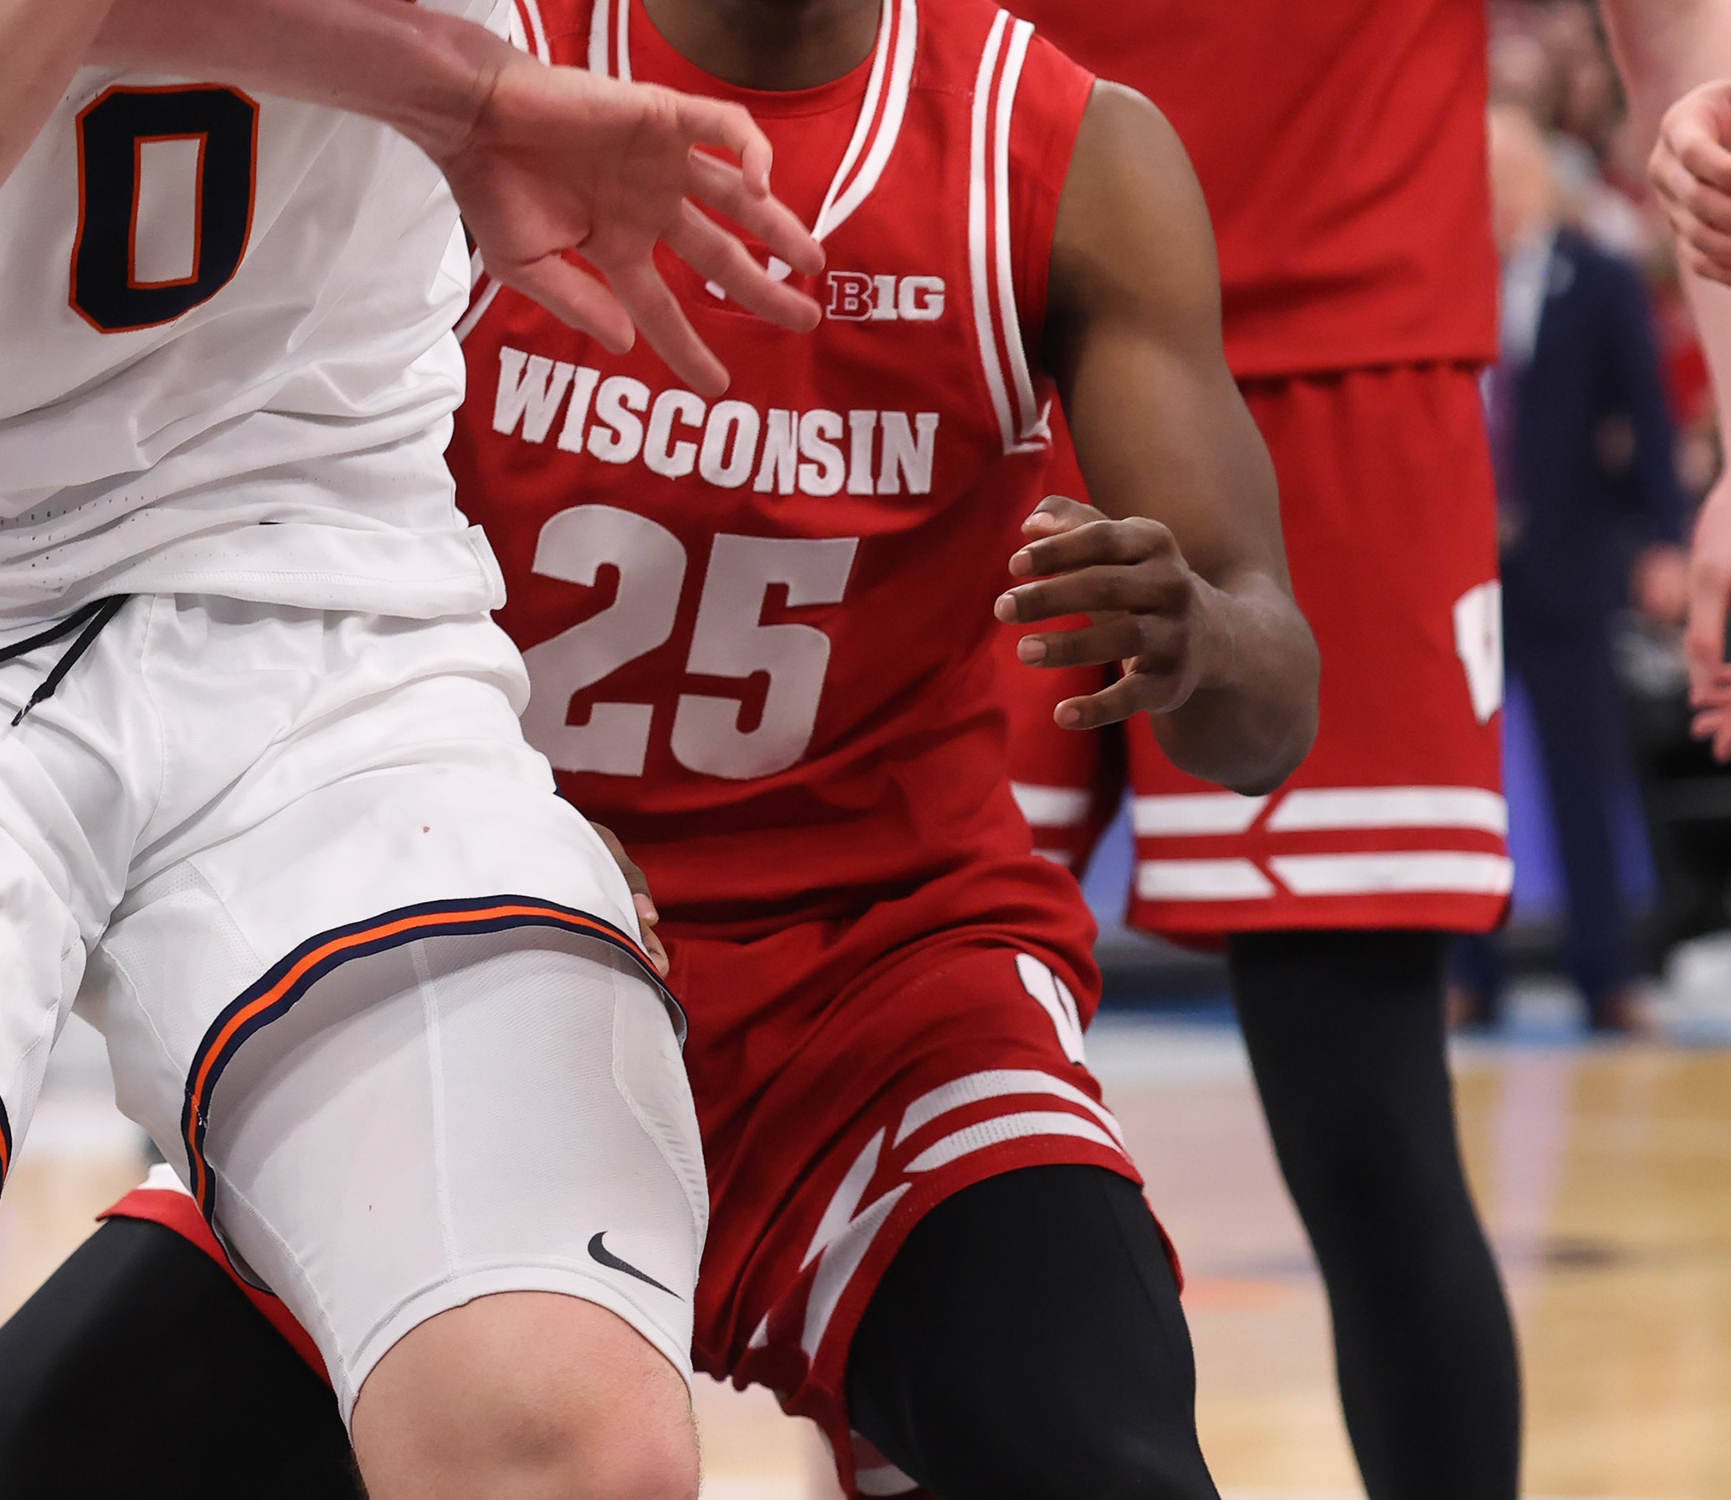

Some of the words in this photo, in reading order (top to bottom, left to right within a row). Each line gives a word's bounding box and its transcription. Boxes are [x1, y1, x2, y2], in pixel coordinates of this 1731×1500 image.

[69, 82, 260, 334] 0
[492, 345, 940, 497] WISCONSIN
[519, 503, 860, 781] 25
